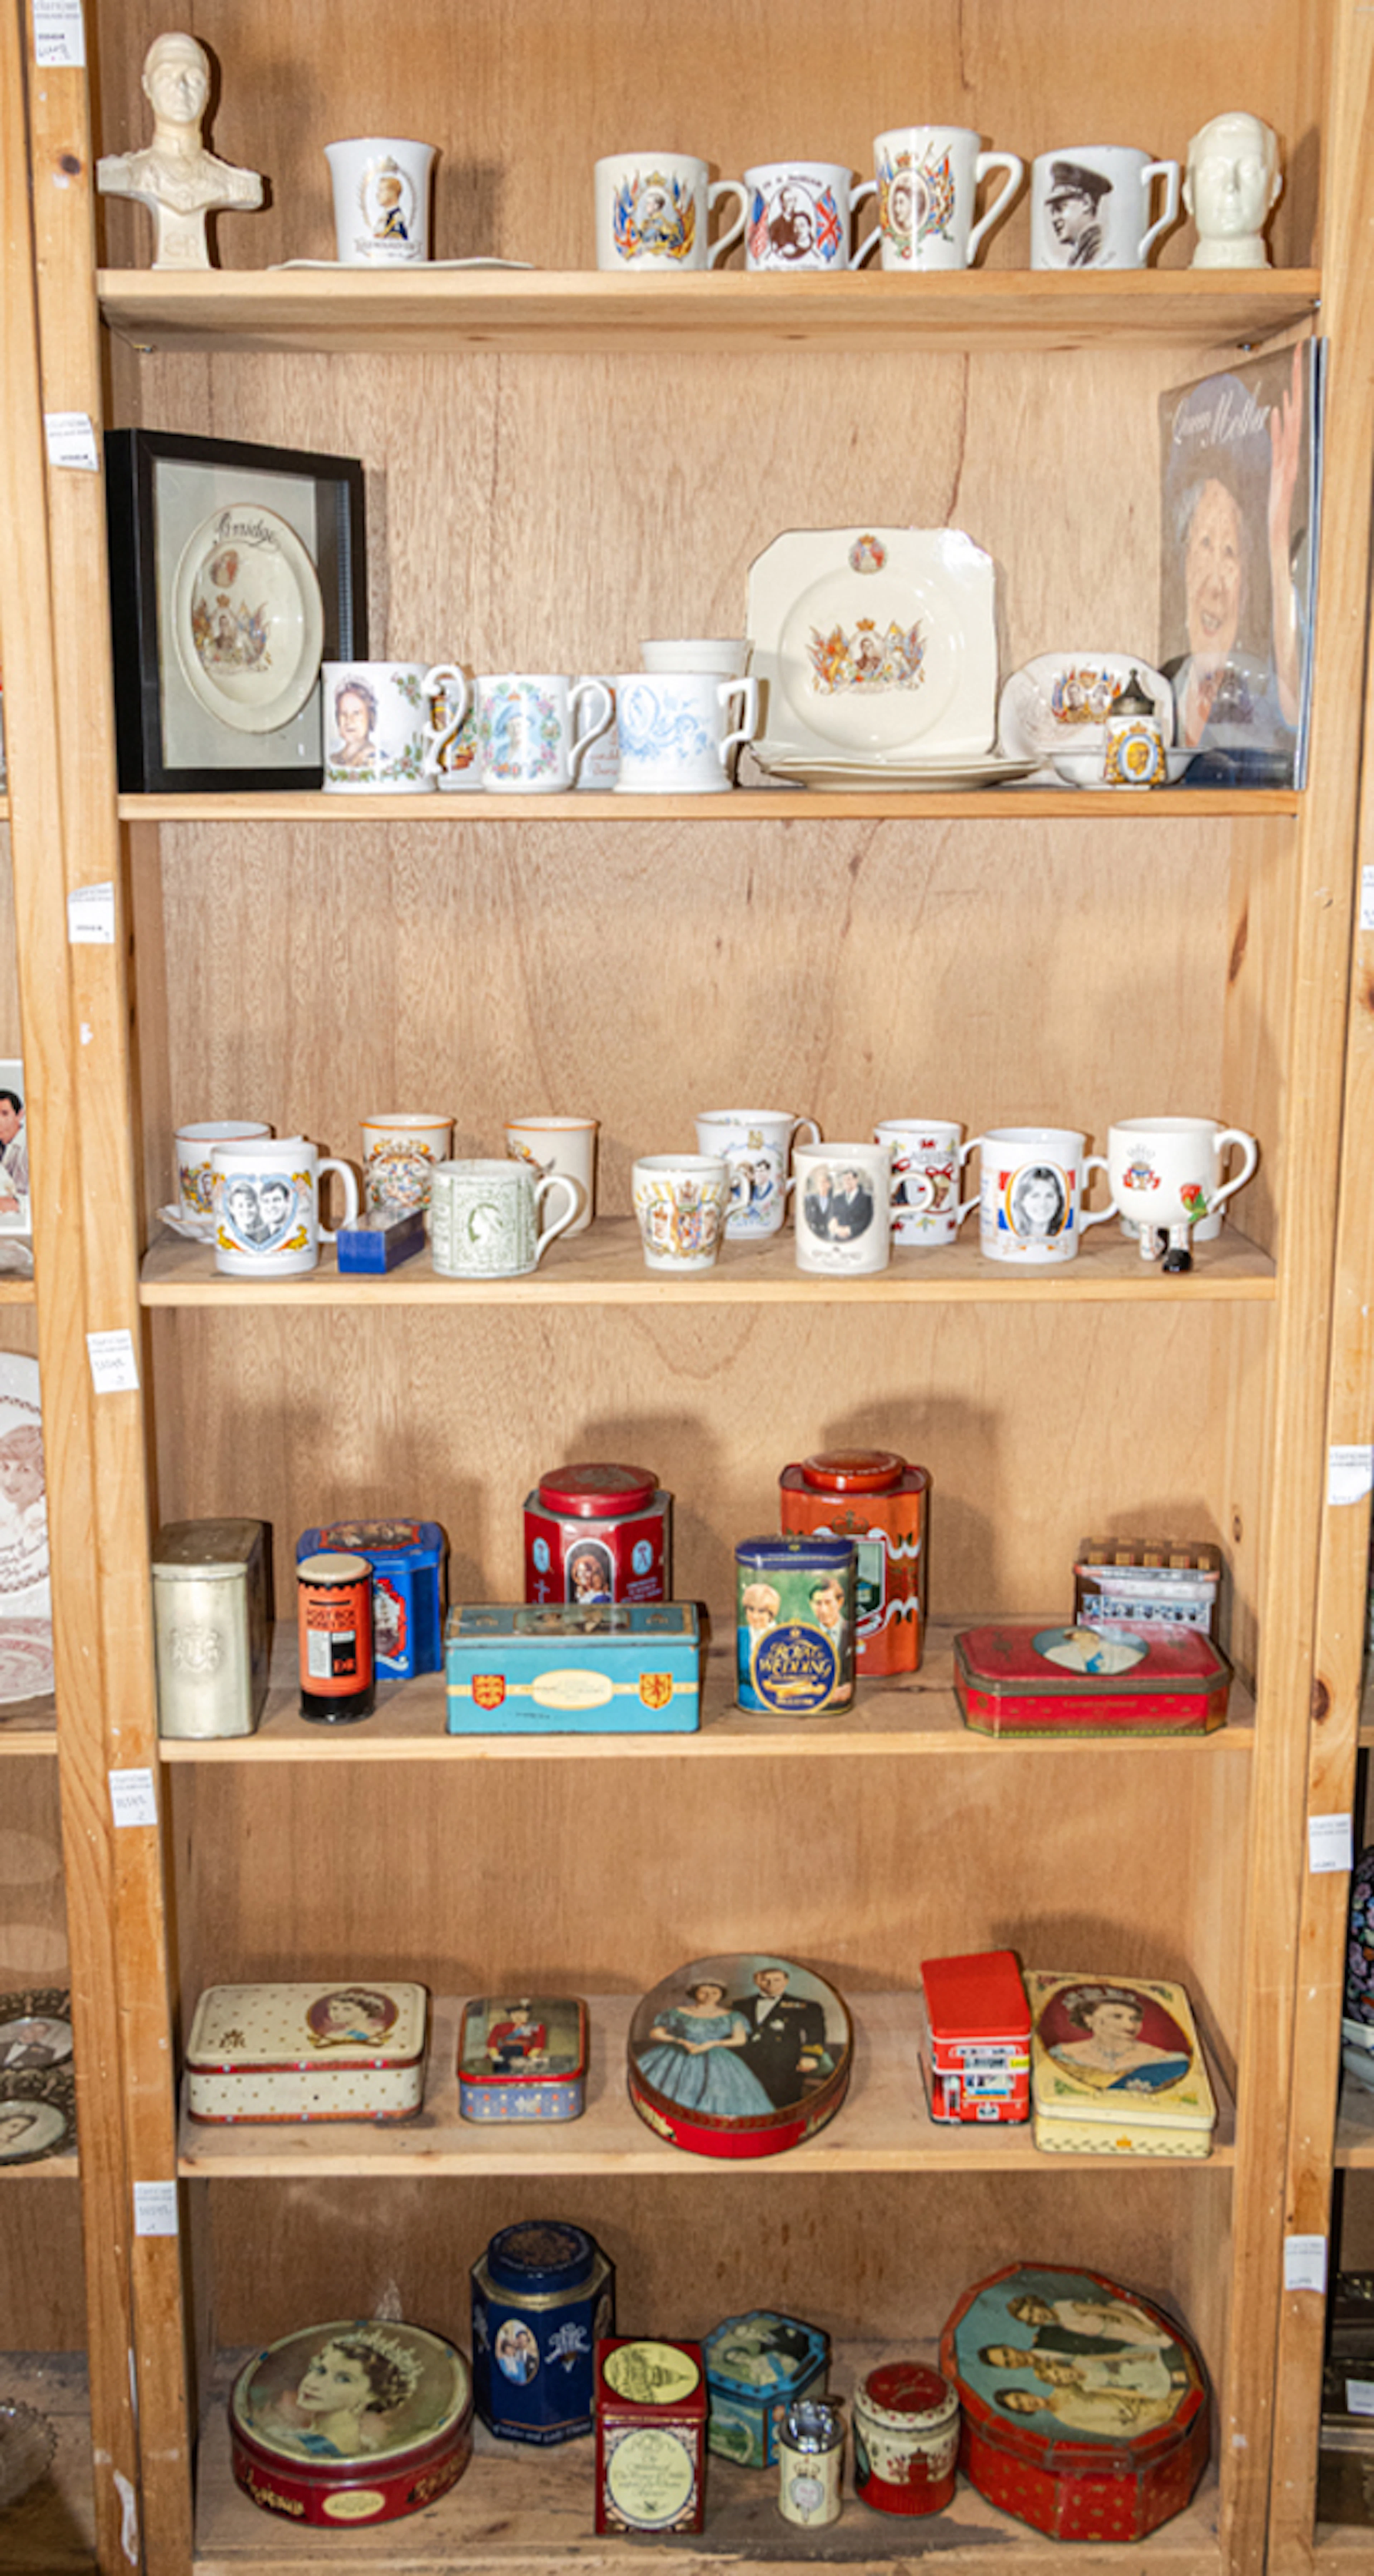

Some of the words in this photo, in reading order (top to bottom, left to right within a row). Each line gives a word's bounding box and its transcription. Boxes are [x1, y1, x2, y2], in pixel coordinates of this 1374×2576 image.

[307, 1609, 331, 1621] POST
[335, 1609, 355, 1620] BOX
[768, 1639, 824, 1661] ROYAL
[759, 1658, 832, 1678] WEDDING
